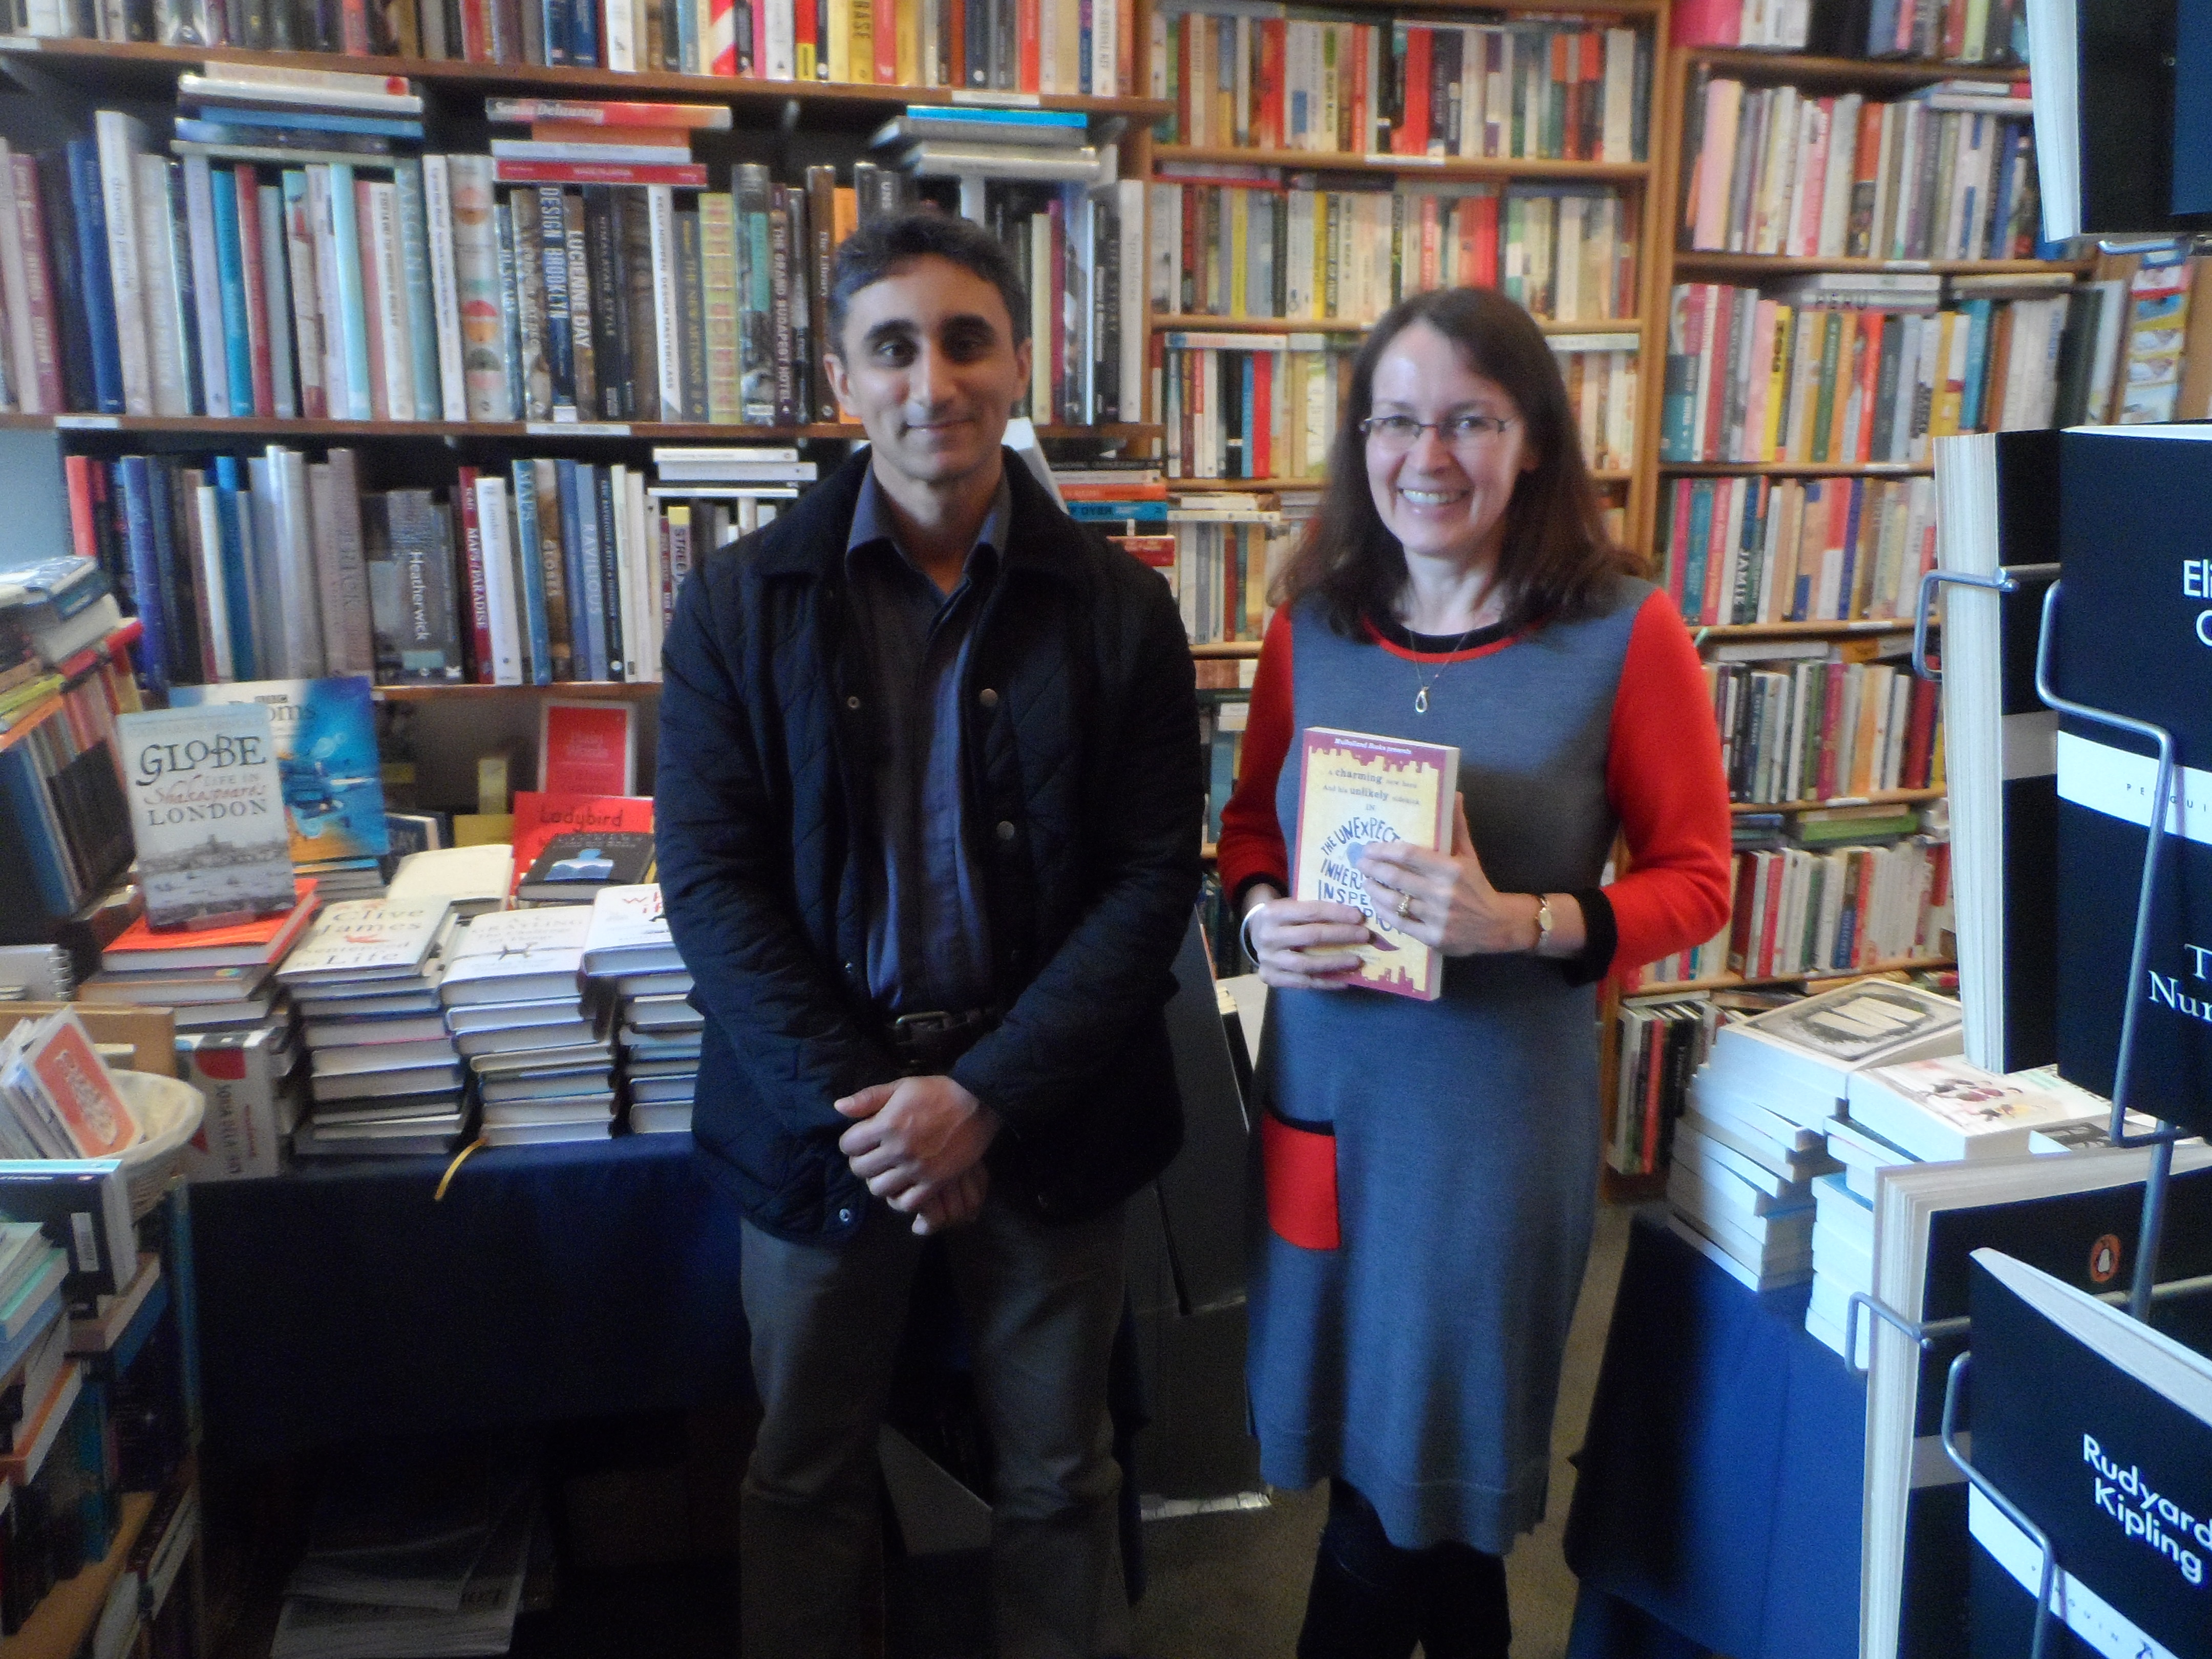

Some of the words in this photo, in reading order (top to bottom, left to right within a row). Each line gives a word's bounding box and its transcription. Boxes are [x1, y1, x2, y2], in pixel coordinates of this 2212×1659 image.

[538, 186, 564, 239] DESIGN
[774, 226, 786, 249] THE
[543, 247, 571, 320] BROOKLYN
[566, 229, 592, 310] LUCIENNE
[775, 252, 787, 294] GRAND
[573, 315, 593, 350] DAY
[776, 299, 790, 363] BUDAPEST
[779, 367, 792, 403] HOTEL
[517, 470, 534, 523] MAPS
[582, 523, 601, 615] RAVILIOUS
[1732, 547, 1751, 605] JAMIE
[409, 550, 431, 640] Heatherwick
[470, 569, 488, 630] PARADISE
[135, 733, 267, 787] GLOBE
[1335, 768, 1383, 784] charming
[147, 799, 267, 826] LONDON
[1350, 789, 1389, 802] unlikely
[1365, 803, 1376, 812] IN
[540, 802, 624, 833] Ladybird
[1320, 835, 1338, 856] THE
[319, 920, 422, 935] James
[331, 908, 424, 921] Clive
[326, 949, 398, 966] Life
[2083, 1433, 2212, 1550] Rudyard
[2095, 1477, 2203, 1585] Kipling
